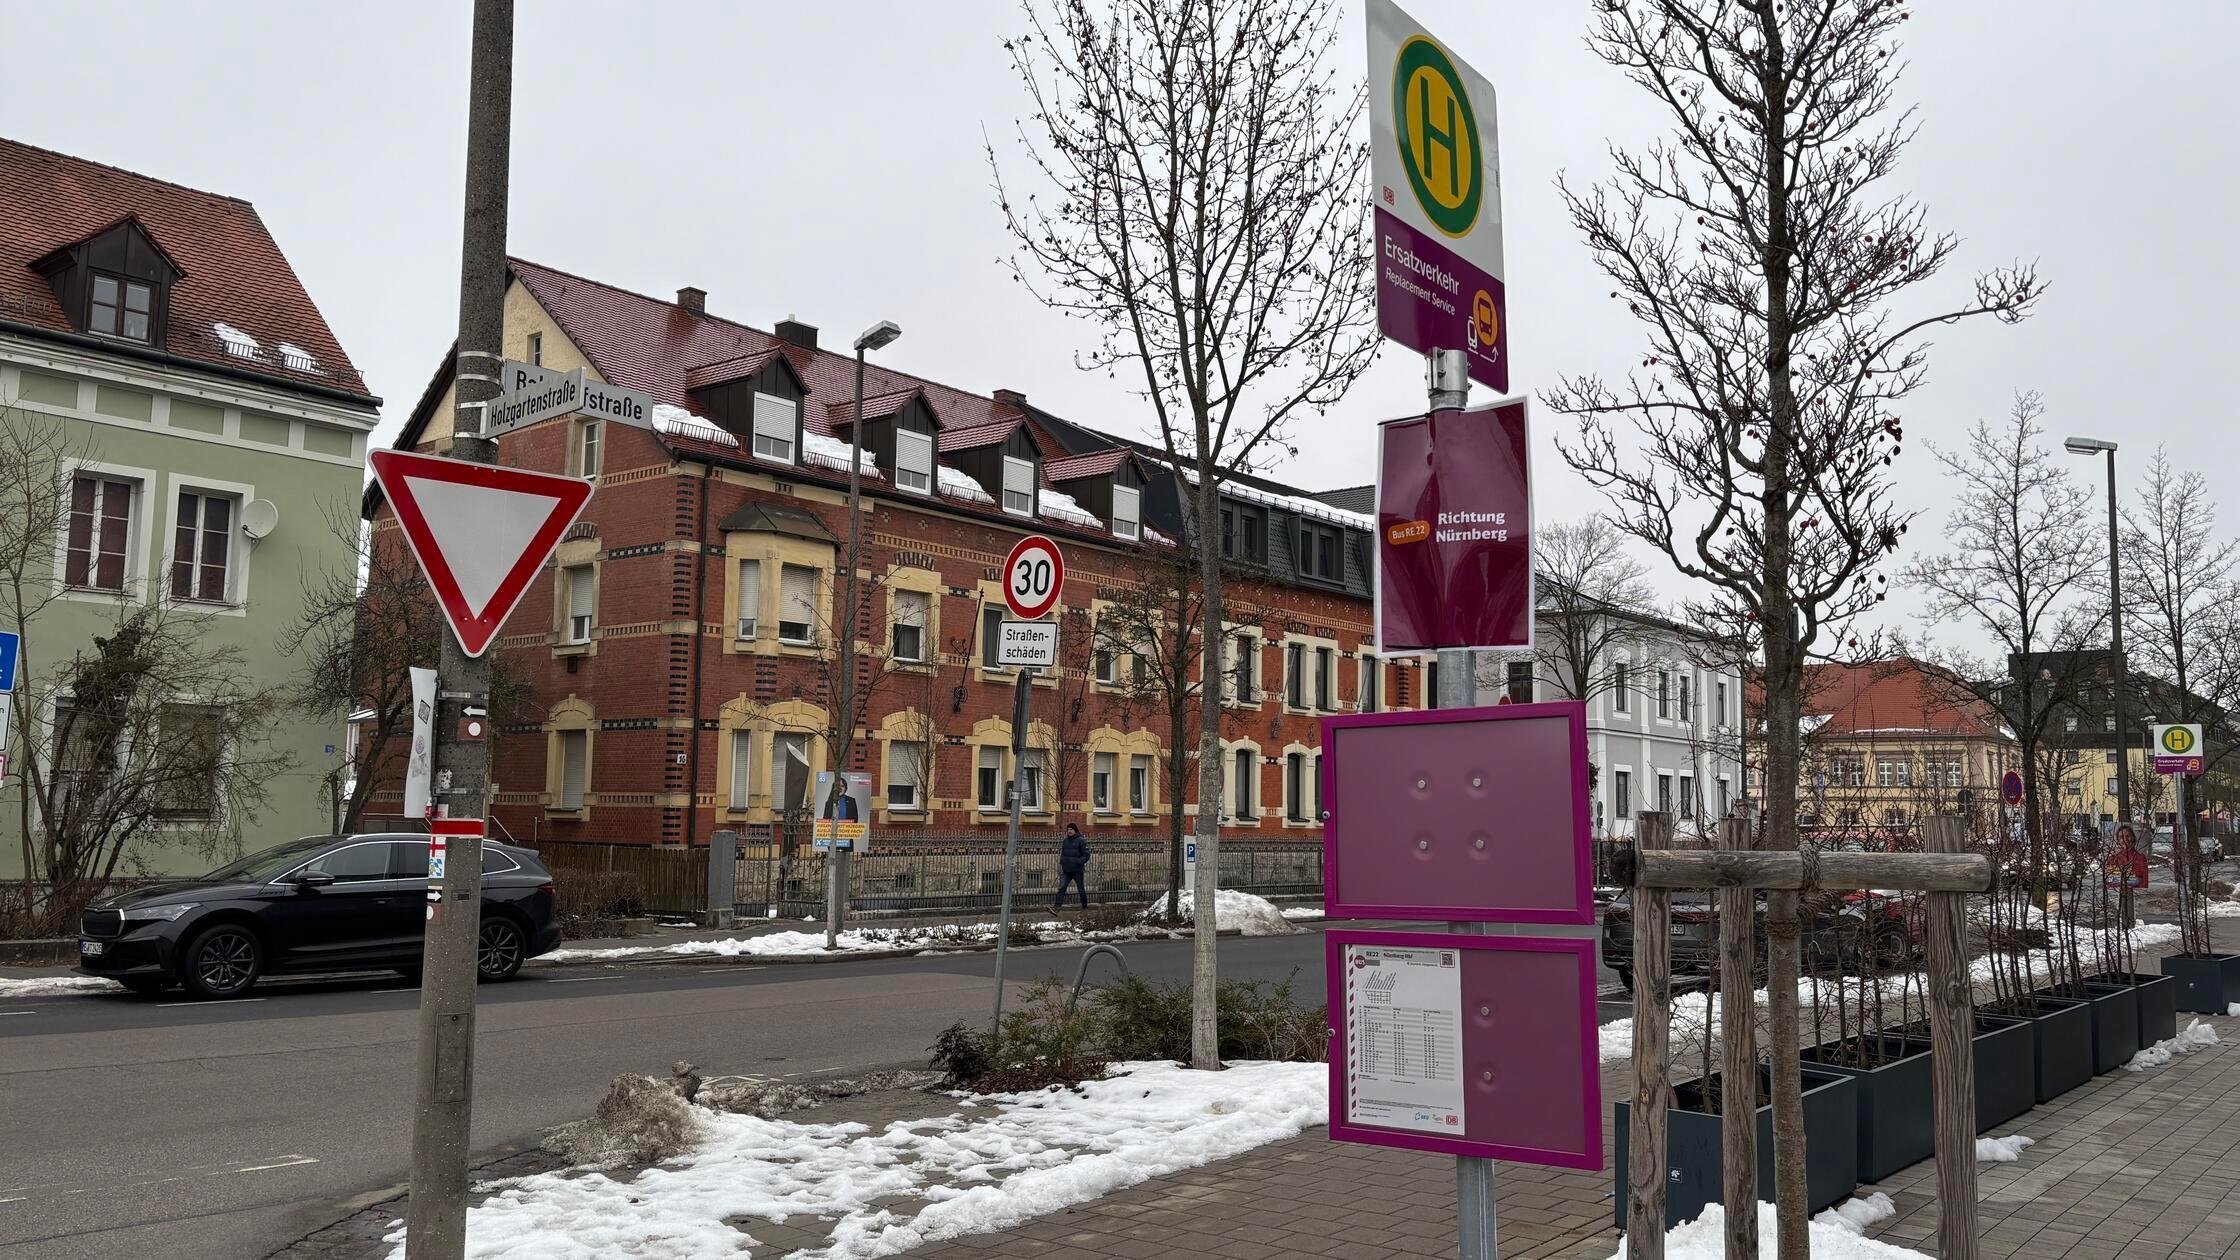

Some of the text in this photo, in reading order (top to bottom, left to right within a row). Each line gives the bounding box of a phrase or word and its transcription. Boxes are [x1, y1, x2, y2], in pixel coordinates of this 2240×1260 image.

[1420, 75, 1459, 198] H
[1385, 234, 1459, 296] Ersatzverkehr
[1386, 267, 1455, 316] Replacement Service
[491, 379, 576, 428] Holzgartenstraße
[1438, 511, 1505, 525] Richtung
[1392, 530, 1405, 540] Bus
[1436, 528, 1507, 542] Nürnberg
[1015, 559, 1050, 596] 30
[1006, 628, 1049, 641] Straßen-
[1006, 646, 1046, 659] schäden
[2171, 732, 2184, 747] H
[1188, 845, 1193, 855] P
